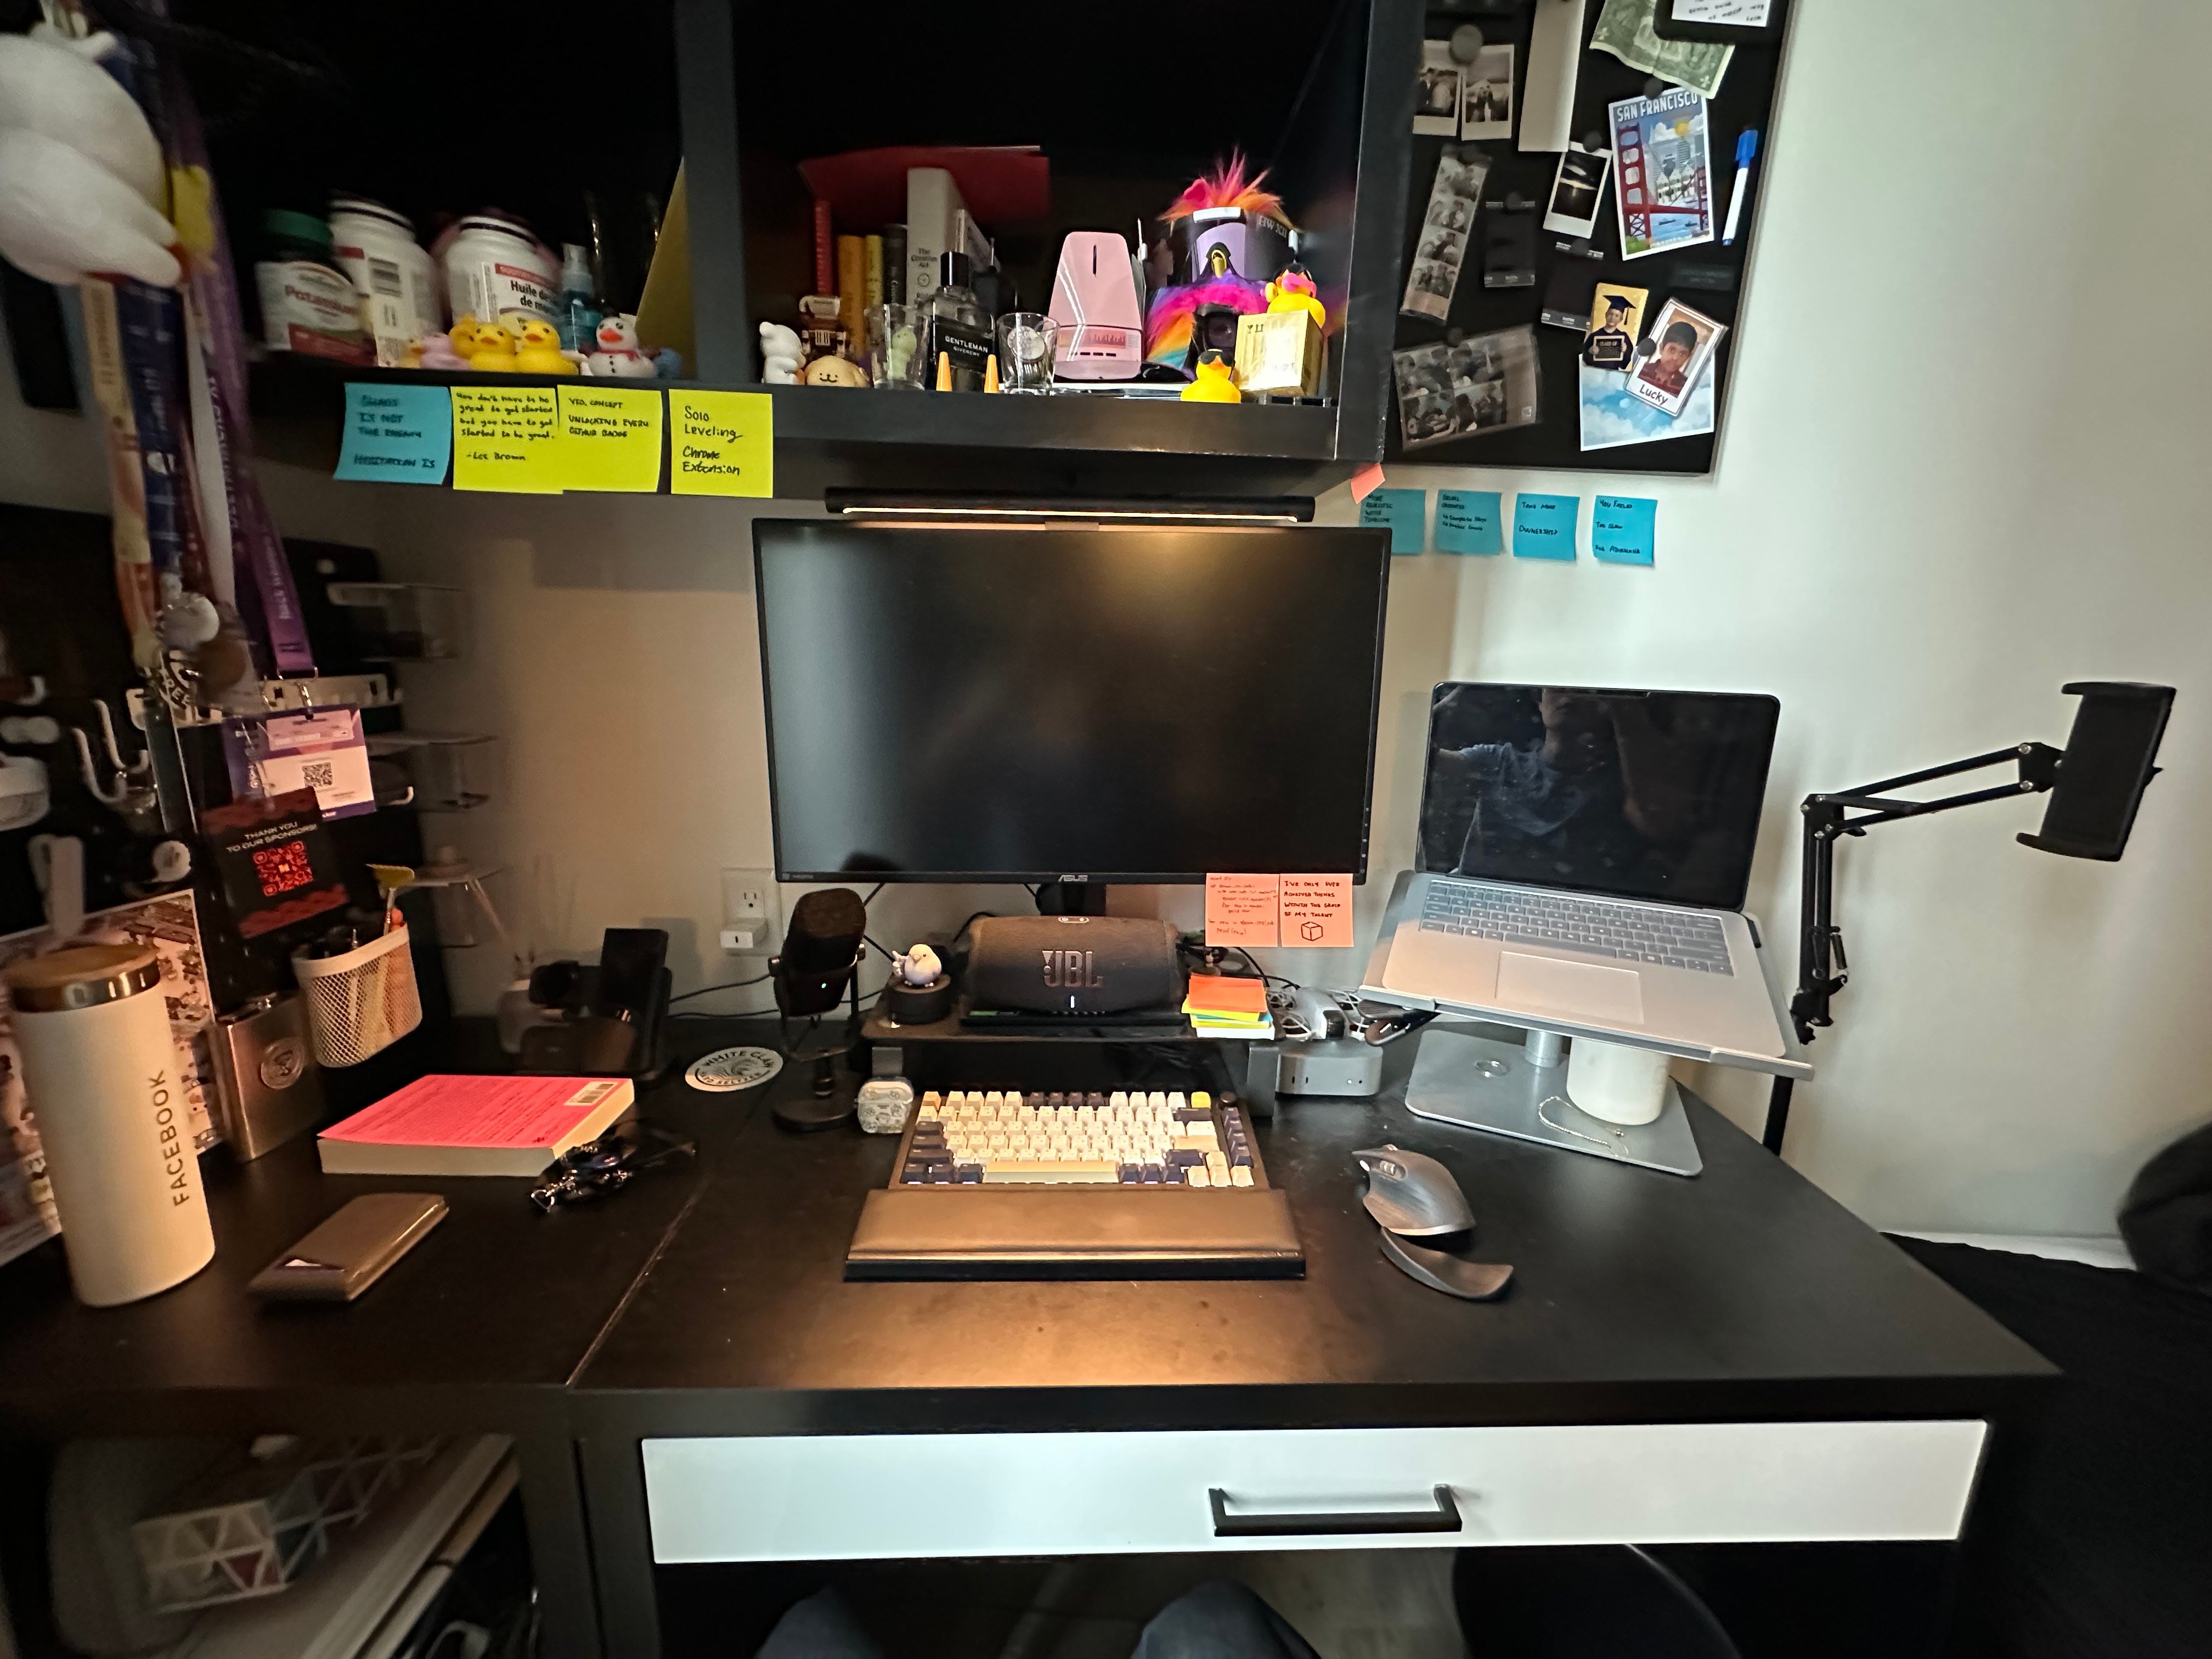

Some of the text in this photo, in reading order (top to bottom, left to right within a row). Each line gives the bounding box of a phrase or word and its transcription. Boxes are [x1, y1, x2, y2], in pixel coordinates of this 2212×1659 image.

[1617, 91, 1699, 122] SAN FRANCISCO
[510, 280, 537, 297] Huile
[520, 295, 532, 307] de
[945, 335, 988, 353] GENTLEMAN
[1639, 384, 1668, 406] Lucky
[684, 405, 710, 422] Solo
[684, 423, 744, 443] Leveling
[244, 821, 298, 840] THANK YOU
[225, 844, 241, 853] TO
[241, 839, 264, 849] OUR
[1058, 874, 1088, 883] ASUS
[1042, 950, 1103, 988] JBL
[702, 1050, 747, 1067] WHITE
[149, 1069, 190, 1207] FACEBOOK
